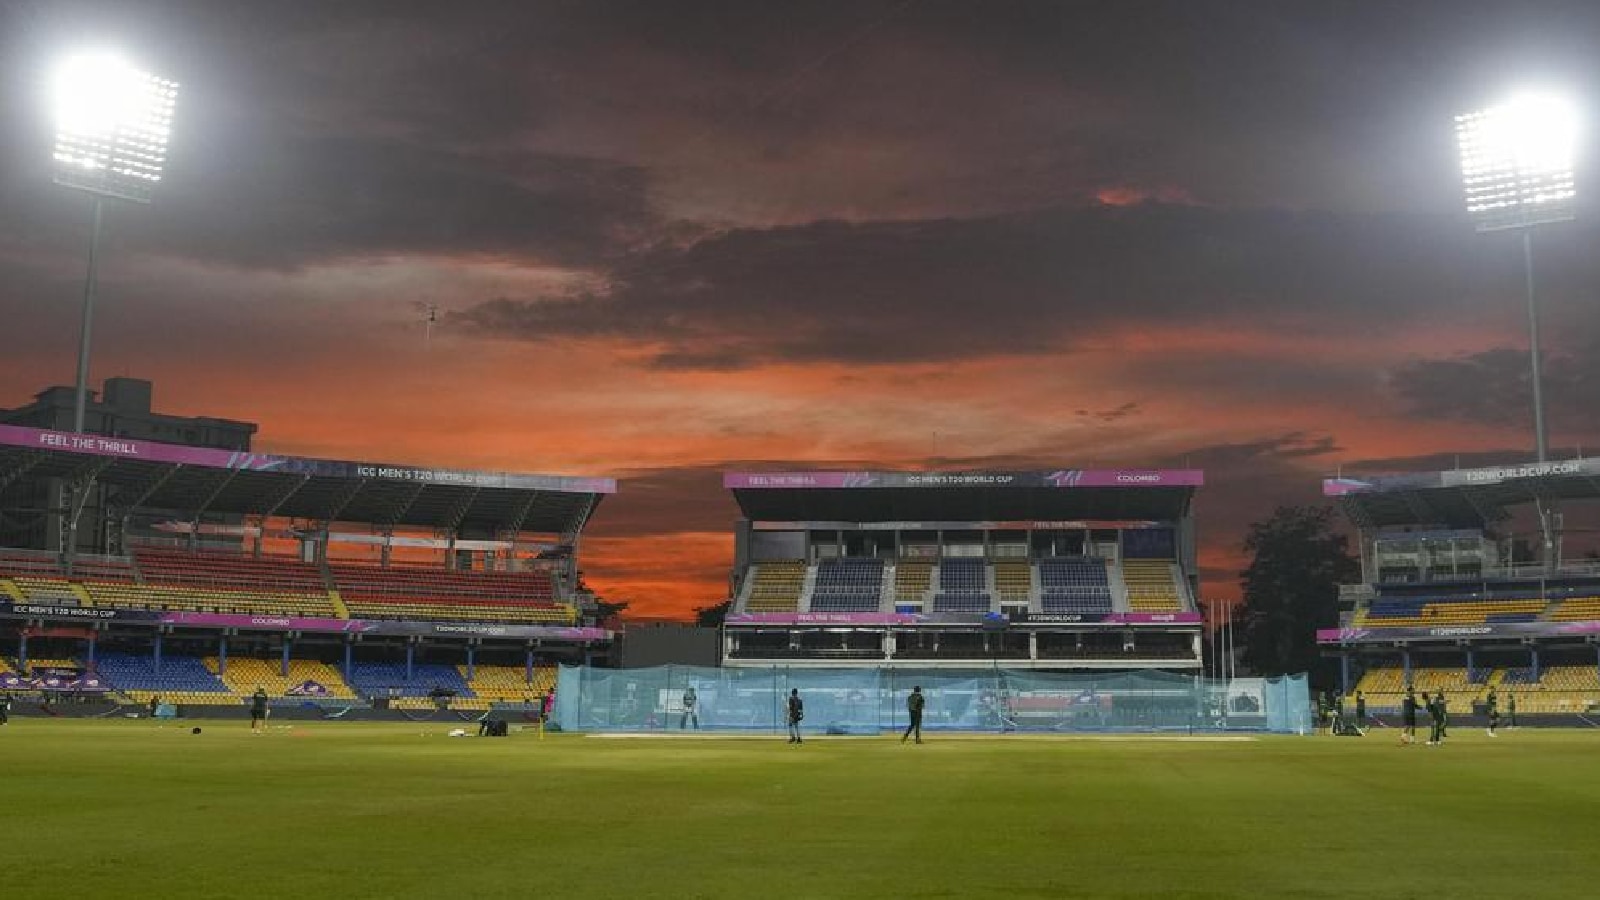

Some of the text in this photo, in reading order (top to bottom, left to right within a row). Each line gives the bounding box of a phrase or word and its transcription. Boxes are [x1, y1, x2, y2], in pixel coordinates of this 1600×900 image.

[40, 433, 138, 453] FEEL THE THRILL
[357, 466, 376, 477] ICC
[378, 468, 411, 479] MEN'S
[413, 470, 433, 481] T20
[434, 471, 473, 482] WORLD
[907, 475, 920, 483] ICC
[964, 475, 995, 483] WORLD
[996, 475, 1013, 483] CUP
[13, 605, 28, 613] ICC
[71, 608, 98, 616] WORLD
[100, 610, 116, 618] CUP
